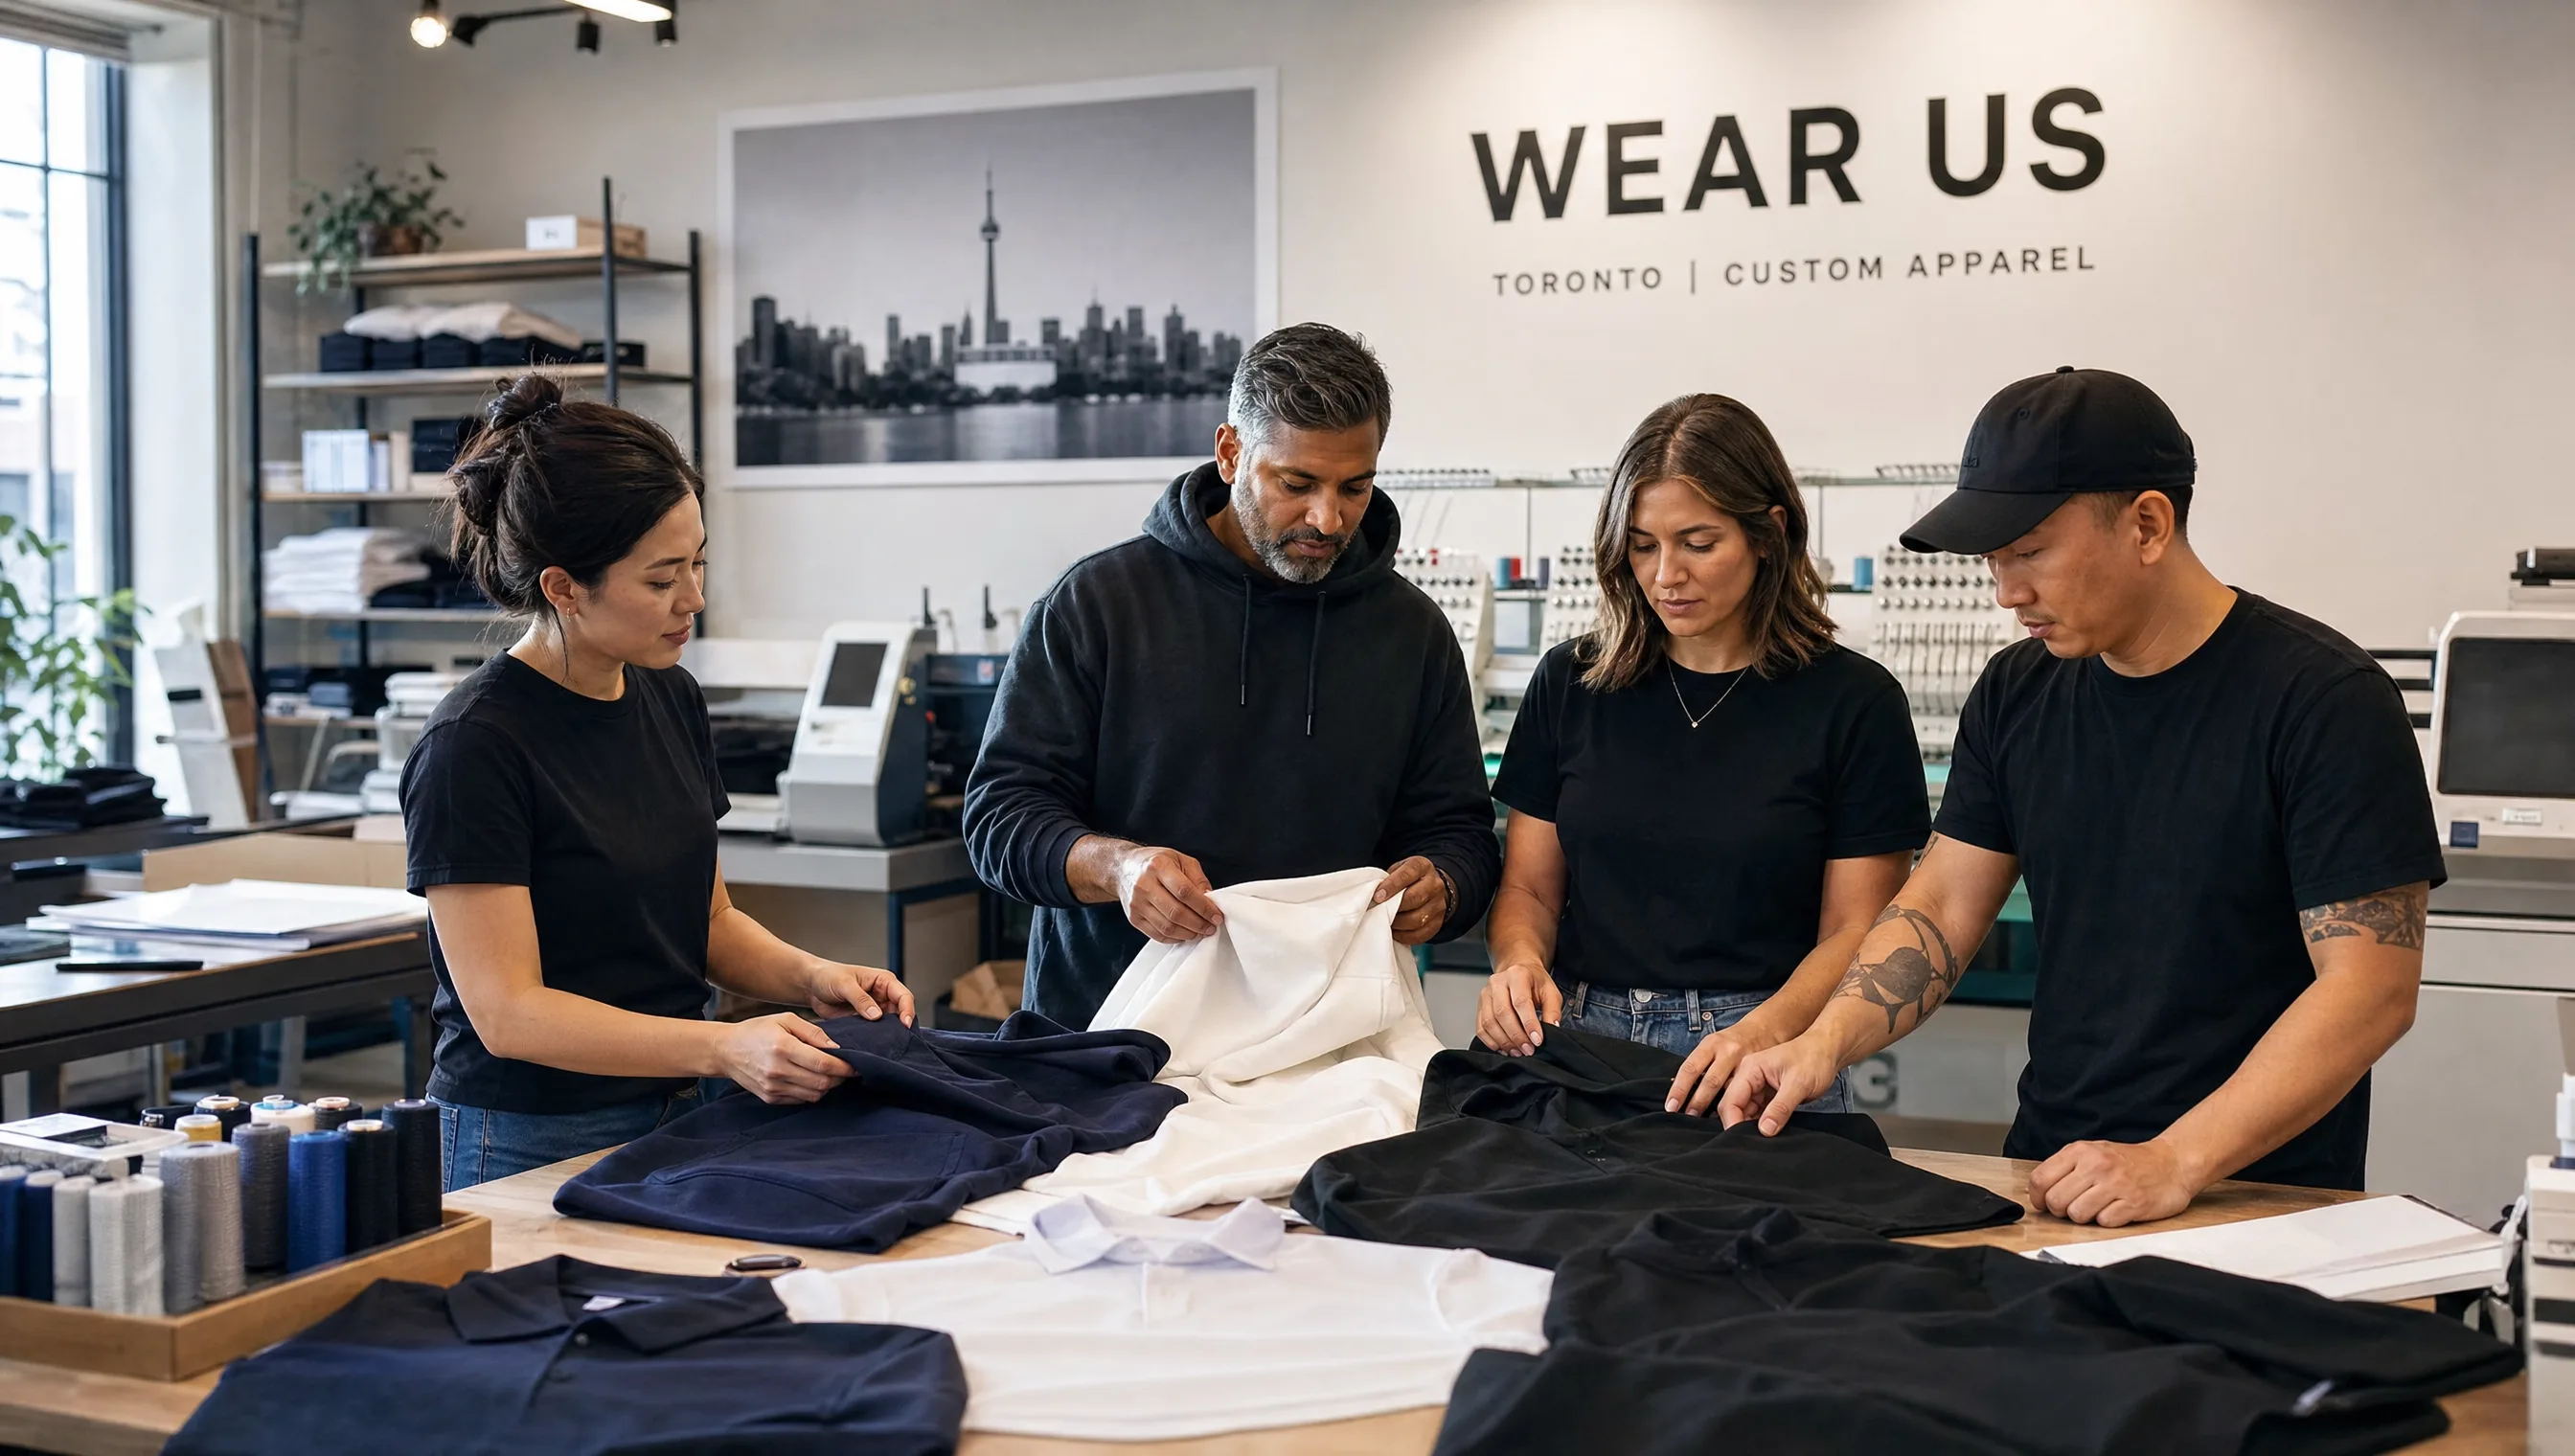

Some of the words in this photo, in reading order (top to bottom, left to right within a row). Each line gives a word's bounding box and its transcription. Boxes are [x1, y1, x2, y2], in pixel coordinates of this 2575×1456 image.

[1470, 104, 1863, 223] WEAR
[1926, 86, 2107, 199] US
[1492, 266, 1663, 297] TORONTO
[1723, 257, 1884, 286] CUSTOM
[1907, 246, 2095, 279] APPAREL
